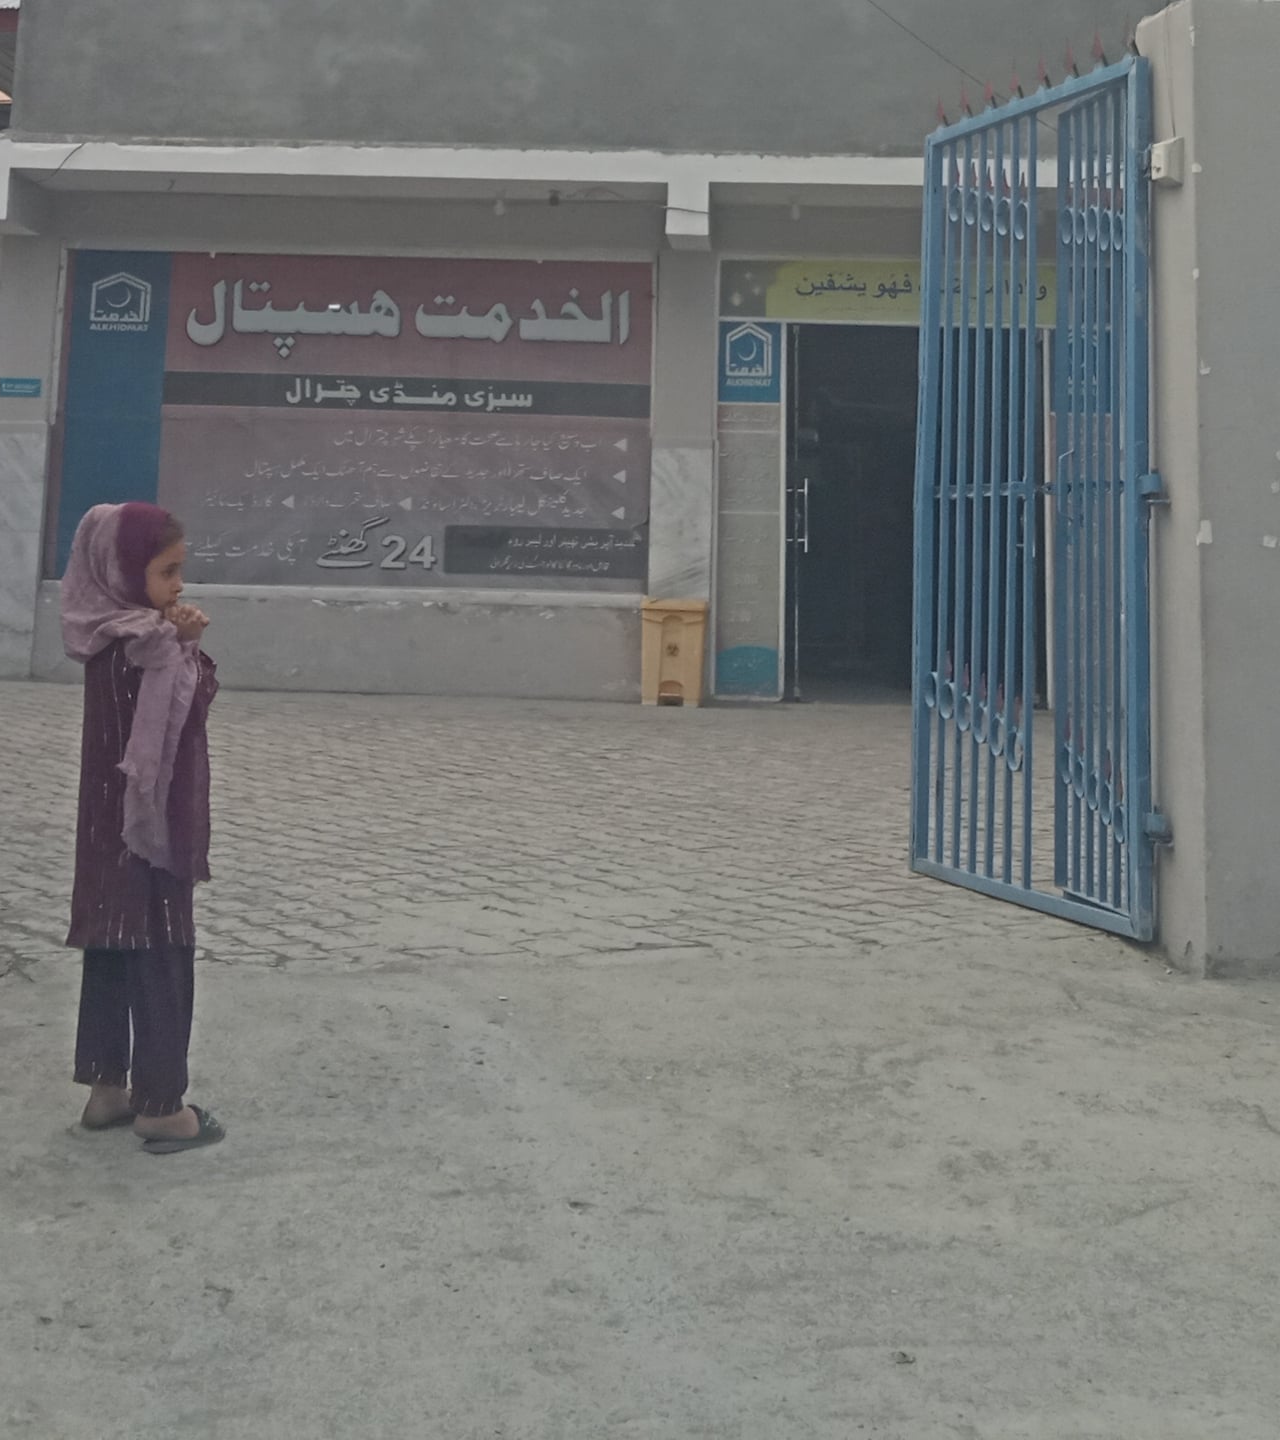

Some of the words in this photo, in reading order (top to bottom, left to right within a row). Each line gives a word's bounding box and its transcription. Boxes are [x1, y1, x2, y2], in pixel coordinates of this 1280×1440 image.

[185, 277, 402, 359] هسپتال
[415, 286, 632, 345] الخدمت
[285, 376, 361, 407] چترال
[369, 379, 458, 408] منڈی
[463, 380, 534, 411] سبزی
[316, 516, 390, 567] گھنٹے
[380, 534, 437, 569] 24
